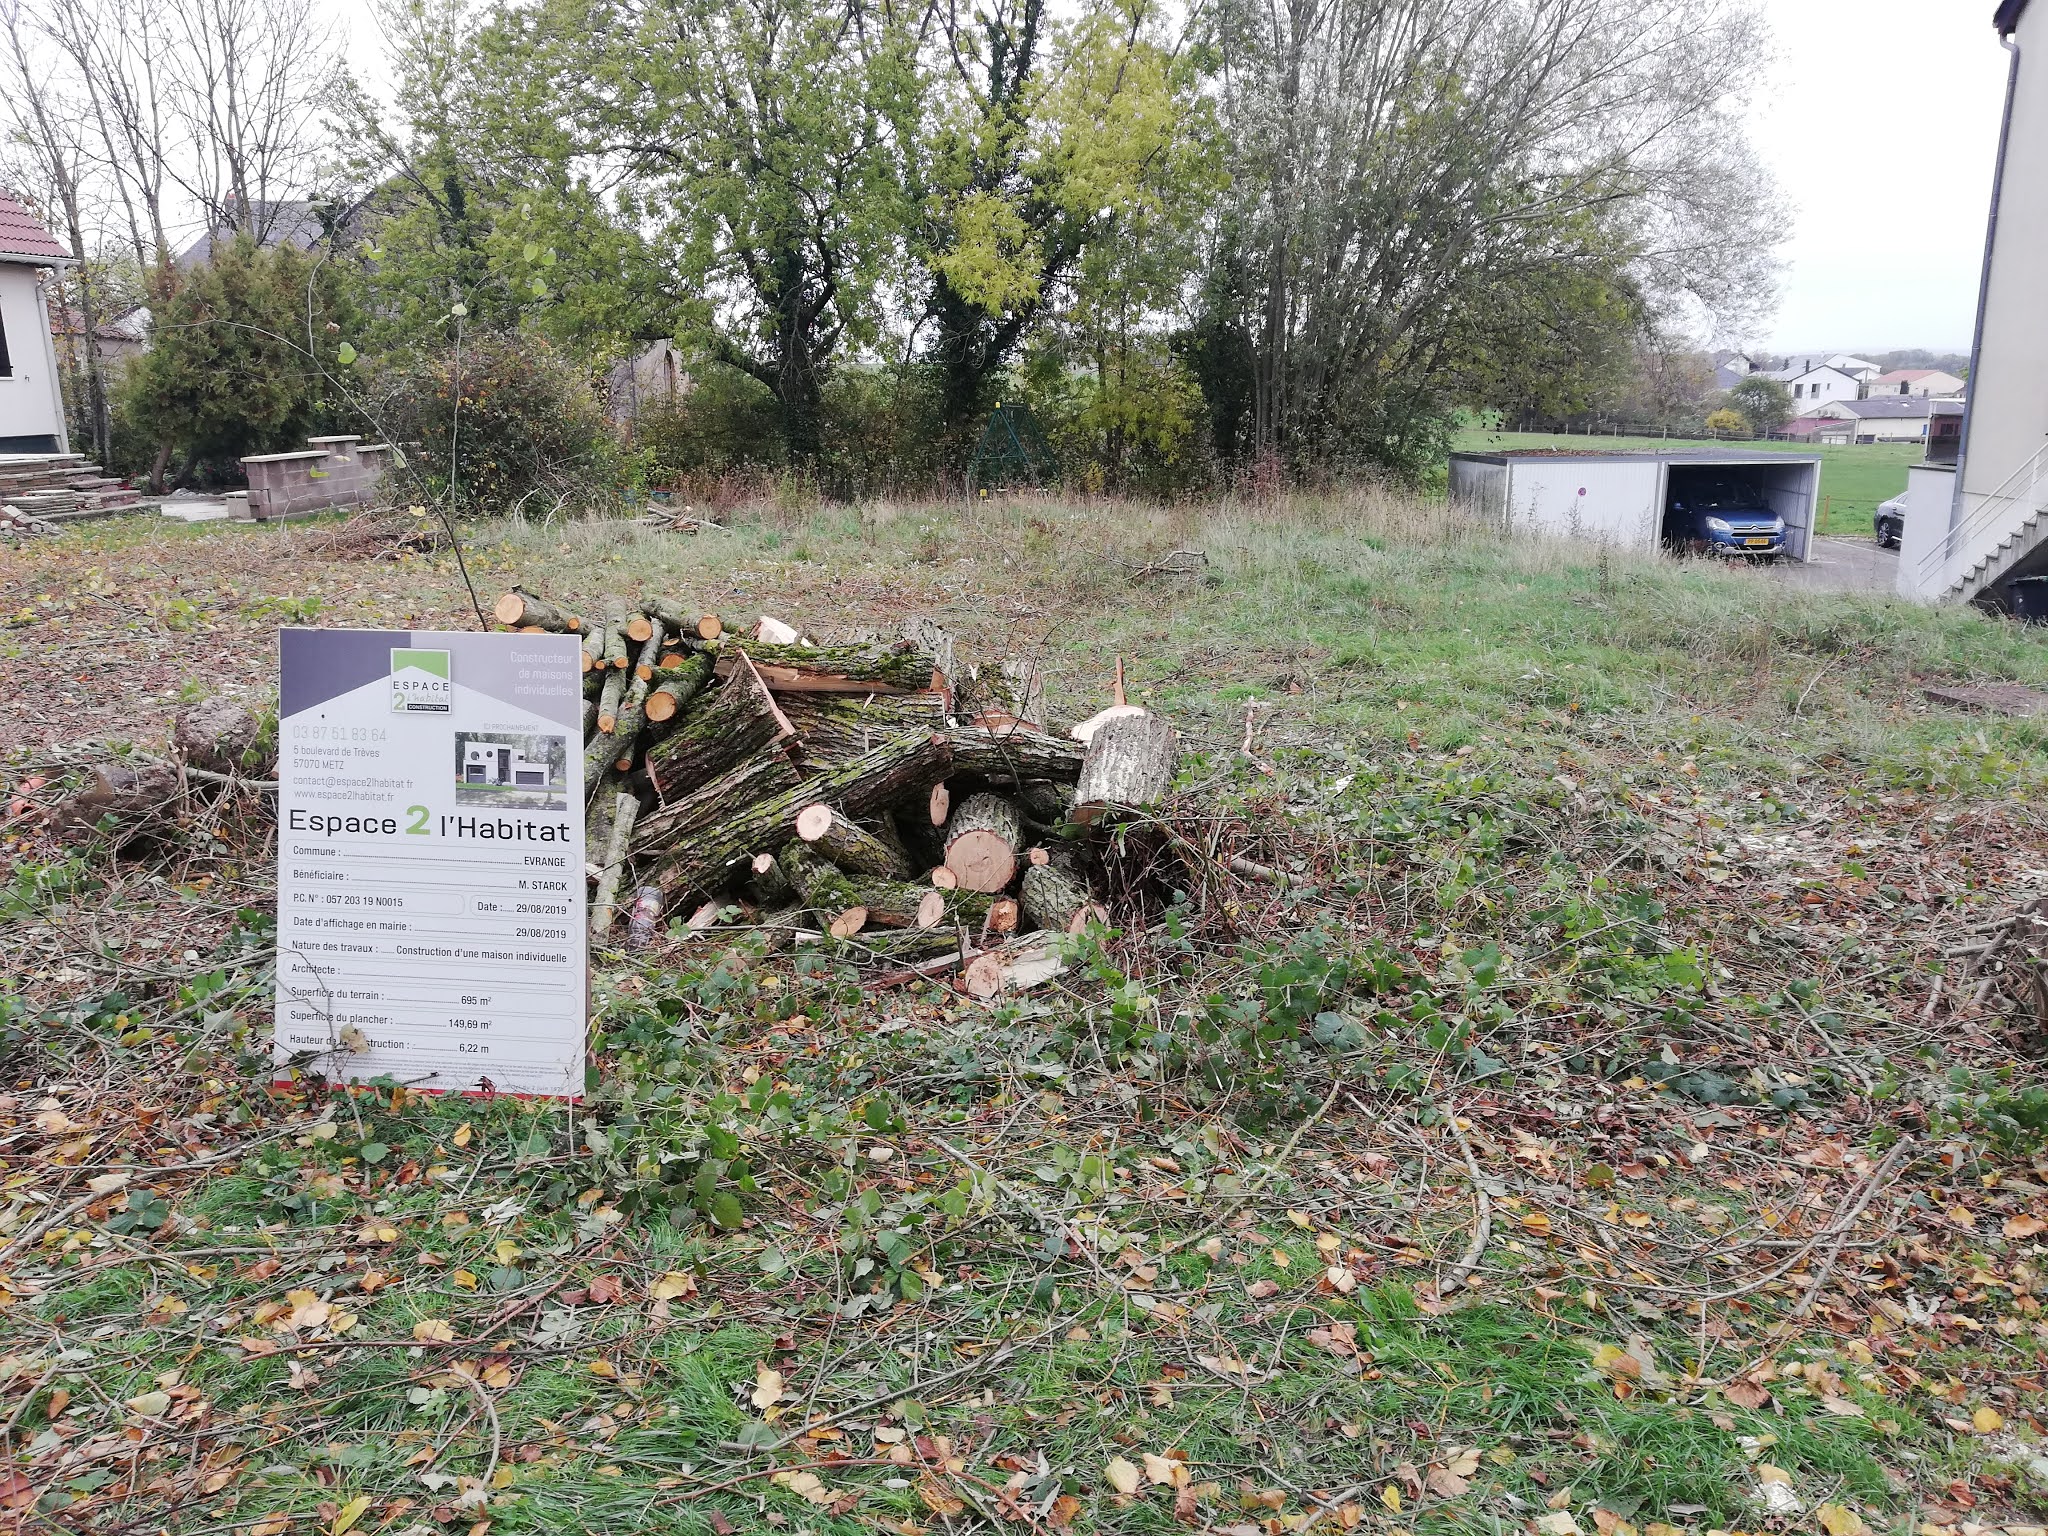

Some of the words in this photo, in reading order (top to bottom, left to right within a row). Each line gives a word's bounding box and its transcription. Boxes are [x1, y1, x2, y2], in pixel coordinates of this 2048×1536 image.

[510, 652, 573, 664] Constructeur
[518, 668, 530, 678] de
[532, 669, 572, 680] maisons
[393, 681, 449, 692] ESPACE
[514, 685, 574, 696] individuelles
[394, 692, 406, 711] 2
[293, 726, 308, 739] 03
[312, 726, 328, 740] 87
[331, 727, 347, 740] 51
[352, 728, 367, 741] 83
[371, 728, 386, 742] 64
[492, 724, 538, 732] PROCHAINEMENT
[294, 745, 298, 754] 5
[302, 746, 340, 756] boulevard
[342, 748, 352, 756] de
[354, 748, 380, 758] Trèves
[294, 758, 320, 768] 57070
[322, 760, 344, 770] METZ
[289, 808, 397, 836] Espace
[405, 804, 430, 836] 2
[441, 815, 570, 842] l'Habitat
[293, 846, 336, 857] Commune
[524, 856, 566, 868] EVRANGE
[293, 869, 344, 881] Bénéficiaire
[518, 880, 530, 890] M.
[532, 881, 568, 892] STARCK
[293, 894, 306, 902] P.C.
[308, 894, 319, 903] N°
[326, 894, 342, 904] 057
[344, 896, 361, 906] 203
[364, 896, 374, 906] 19
[478, 902, 498, 912] Date
[516, 904, 567, 915] 29/08/2019
[294, 916, 313, 926] Date
[316, 918, 364, 931] d'affichage
[366, 920, 377, 930] en
[380, 920, 407, 931] mairie
[516, 928, 567, 939] 29/08/2019
[292, 940, 320, 951] Nature
[322, 942, 338, 952] des
[340, 944, 373, 954] travaux
[396, 945, 452, 958] Construction
[454, 948, 479, 958] d'une
[482, 950, 514, 960] maison
[516, 951, 567, 963] individuelle
[292, 964, 336, 974] Architecte
[291, 986, 334, 999] Superficie
[336, 988, 348, 998] du
[350, 990, 379, 1000] terrain
[461, 996, 478, 1005] 695
[290, 1010, 334, 1023] Superficie
[336, 1012, 348, 1022] du
[350, 1014, 388, 1025] plancher
[448, 1018, 478, 1030] 149,69
[290, 1034, 323, 1045] Hauteur
[326, 1036, 336, 1046] de
[460, 1044, 478, 1054] 6,22
